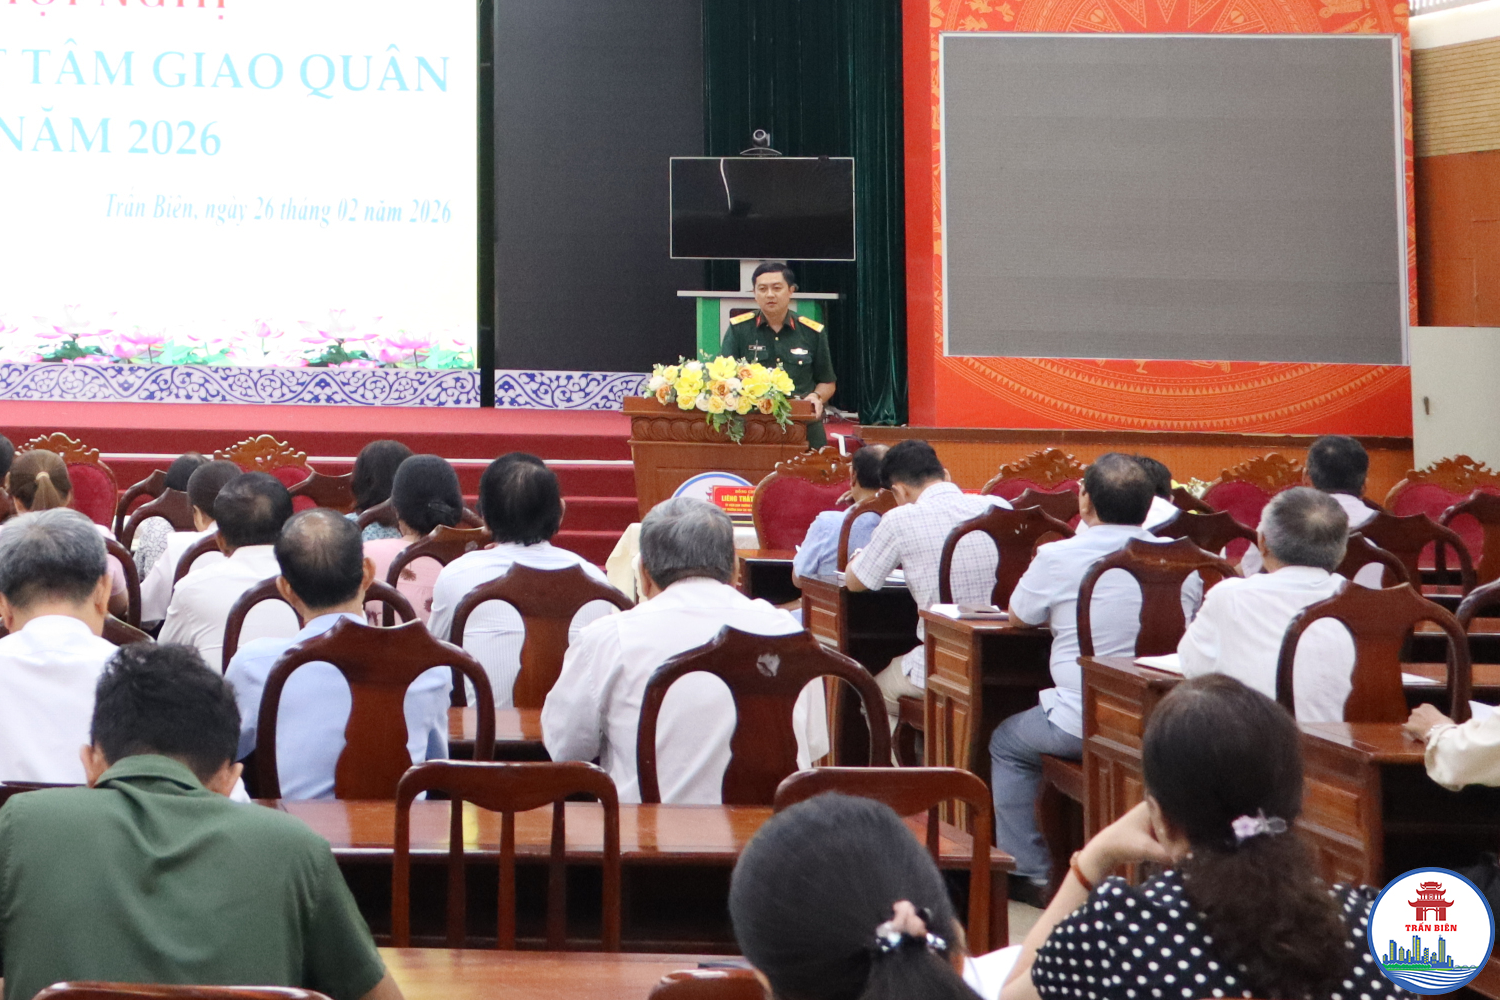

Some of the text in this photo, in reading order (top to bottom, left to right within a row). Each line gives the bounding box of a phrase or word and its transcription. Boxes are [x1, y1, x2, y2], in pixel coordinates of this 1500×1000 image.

[22, 38, 135, 87] TÂM
[152, 50, 284, 91] GIAO
[300, 43, 450, 99] QUÂN
[128, 119, 222, 157] 2026
[106, 186, 451, 228] Trấn Biên, ngày 26 tháng 02 năm 2026
